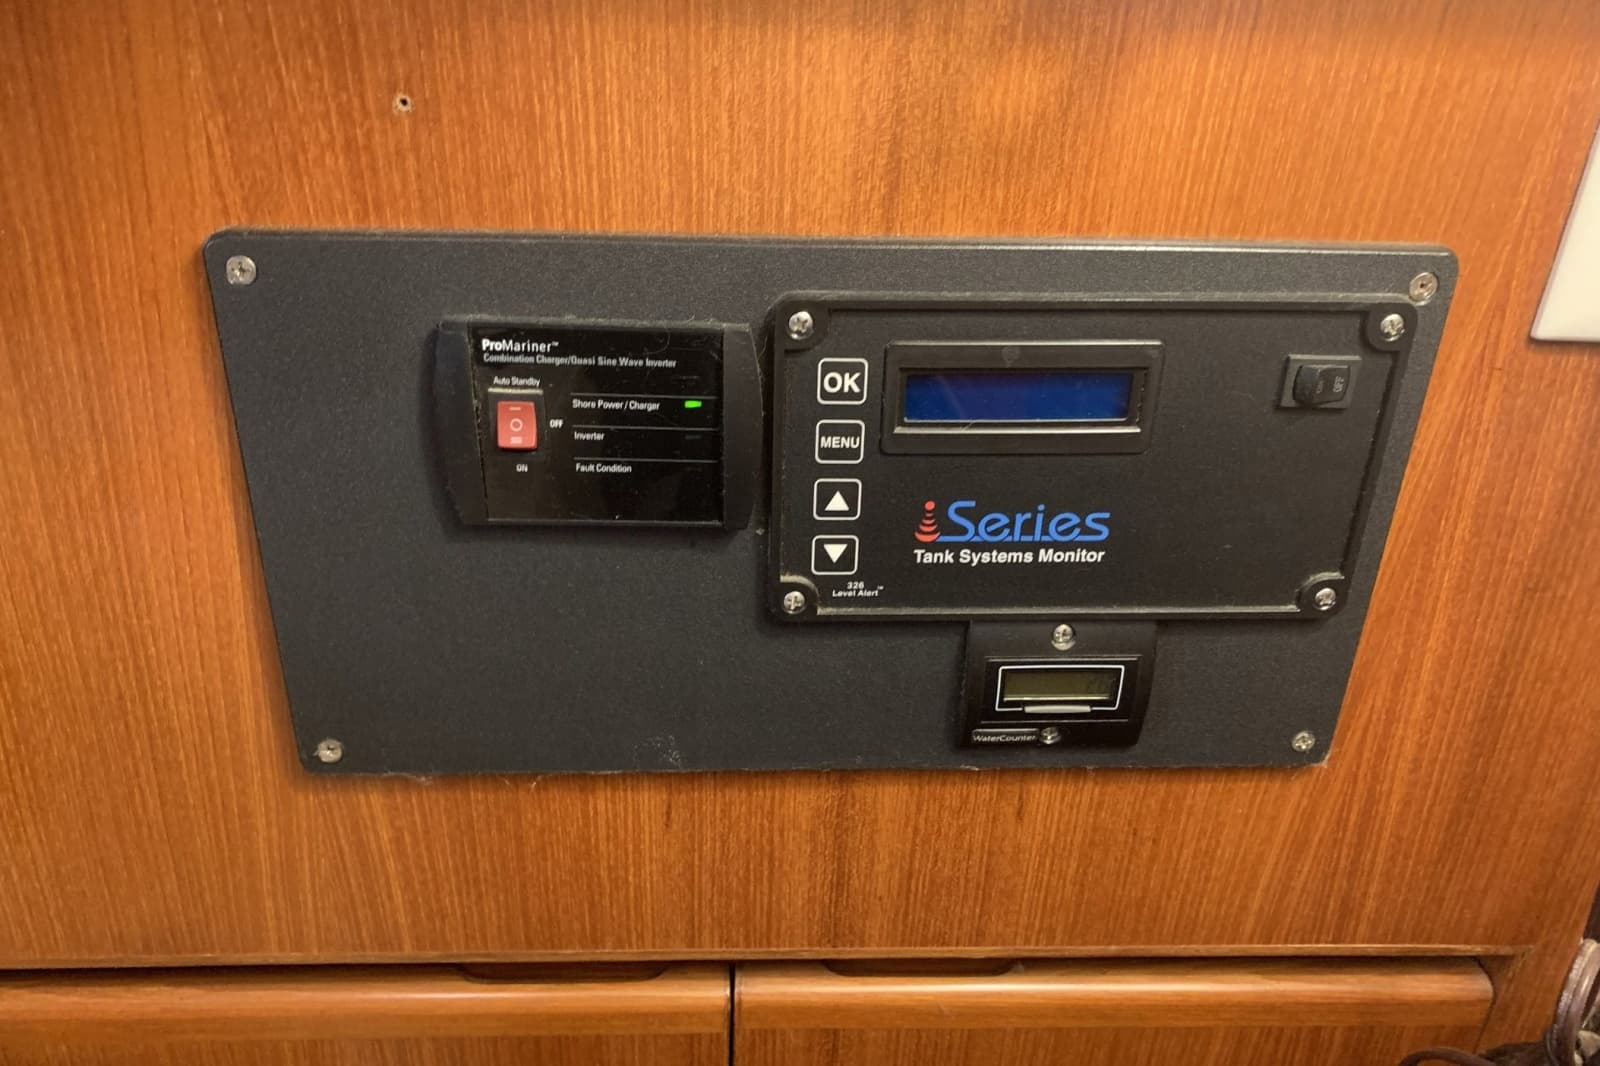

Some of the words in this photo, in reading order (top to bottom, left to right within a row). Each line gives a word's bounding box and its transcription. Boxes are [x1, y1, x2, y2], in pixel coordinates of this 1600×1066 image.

[481, 338, 552, 353] ProMariner
[483, 353, 535, 364] Combination
[598, 357, 617, 367] Sine
[619, 357, 644, 368] Wave
[646, 359, 677, 368] Inverter
[493, 376, 511, 385] Auto
[512, 376, 540, 387] Standby
[823, 372, 861, 393] OK
[572, 399, 596, 409] Shore
[598, 400, 624, 411] Power
[630, 401, 660, 411] Charger
[550, 419, 563, 429] OFF
[574, 431, 605, 440] Inverter
[820, 436, 860, 449] MENU
[516, 464, 528, 473] ON
[576, 464, 595, 472] Fault
[596, 464, 632, 473] Condition
[914, 549, 953, 564] Tank
[958, 548, 1033, 567] Systems
[1038, 548, 1105, 563] Monitor
[847, 581, 864, 590] 326
